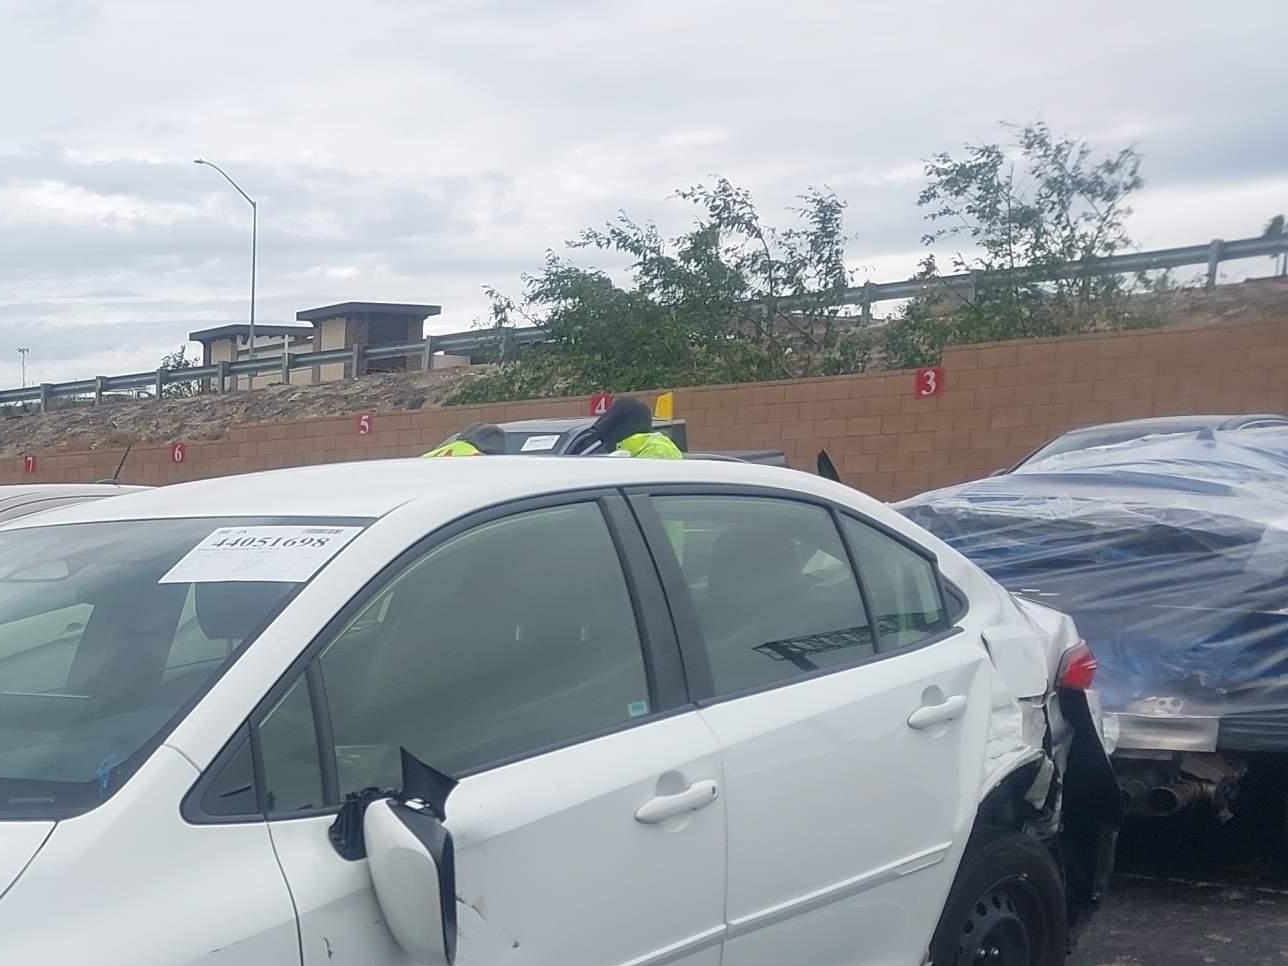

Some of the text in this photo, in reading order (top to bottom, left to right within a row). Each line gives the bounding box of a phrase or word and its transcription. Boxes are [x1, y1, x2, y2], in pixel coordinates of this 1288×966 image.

[921, 370, 936, 395] 3
[595, 396, 607, 415] 4
[360, 415, 369, 434] 5
[175, 444, 182, 462] 6
[211, 537, 330, 547] 44051698
